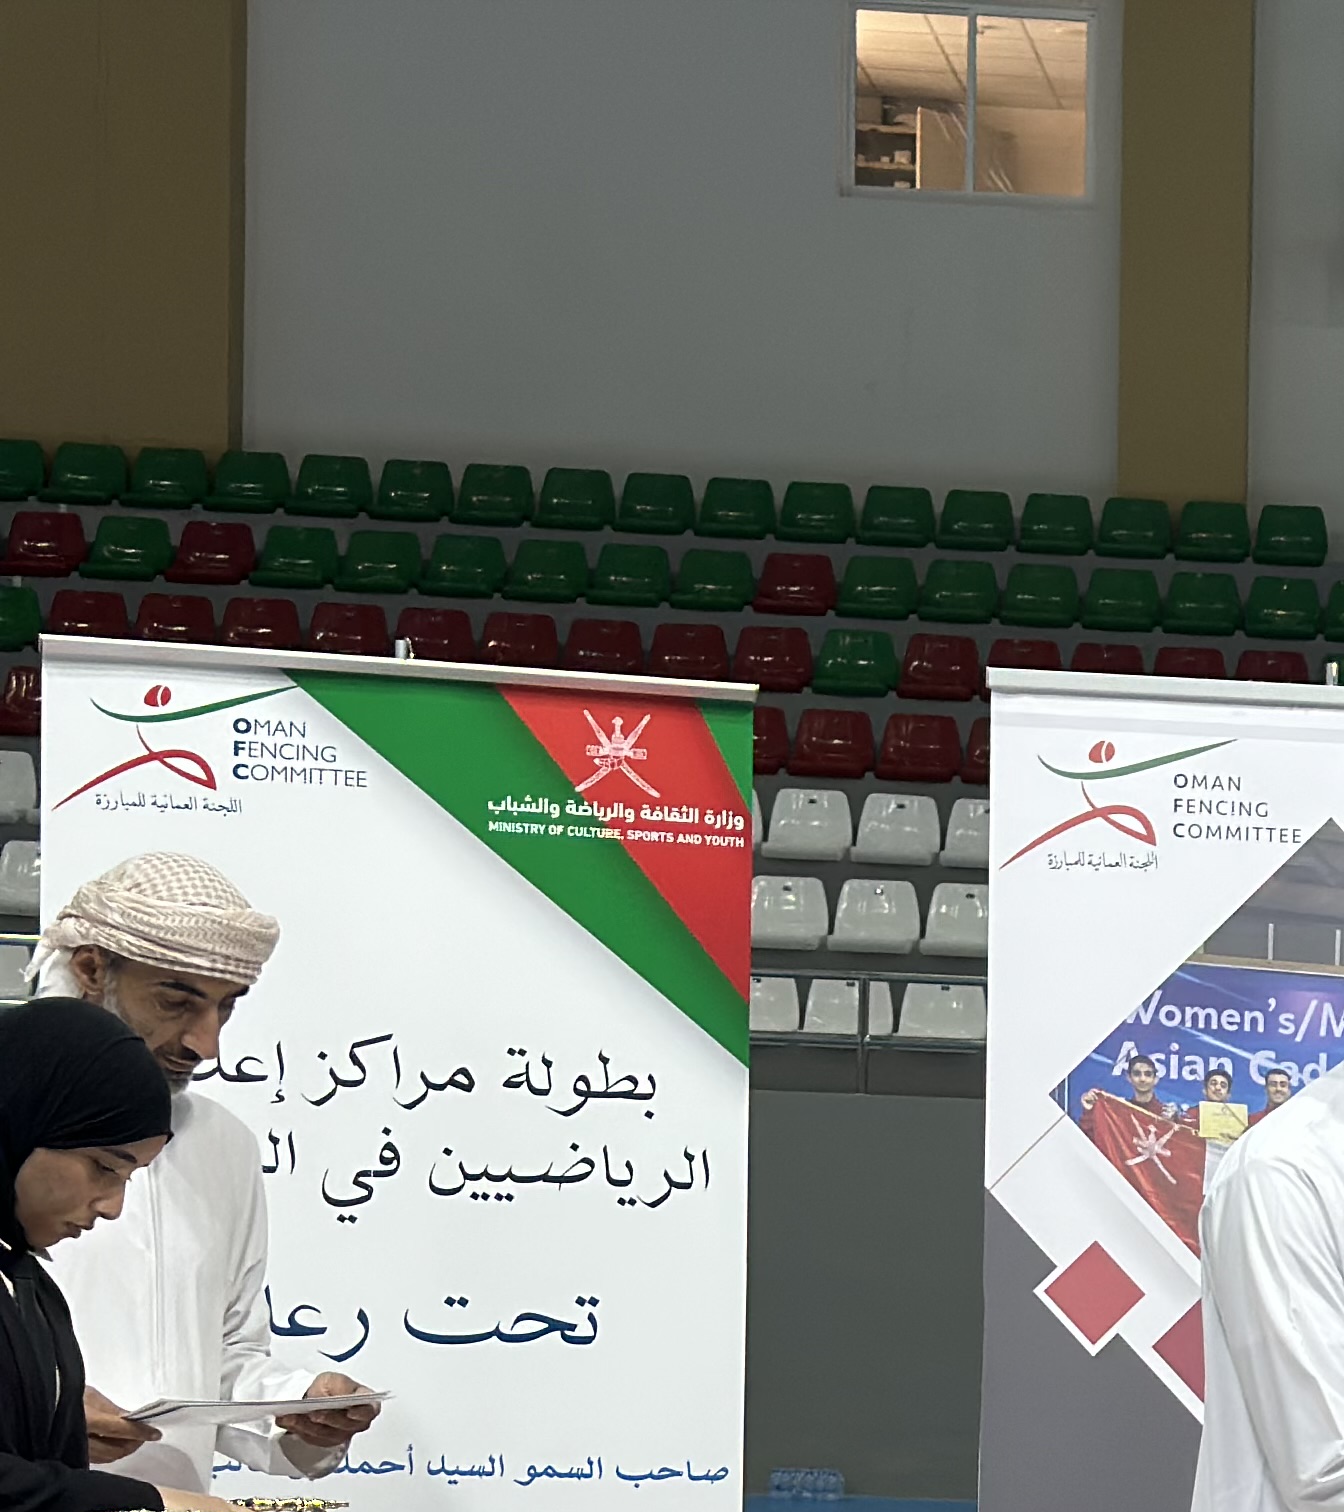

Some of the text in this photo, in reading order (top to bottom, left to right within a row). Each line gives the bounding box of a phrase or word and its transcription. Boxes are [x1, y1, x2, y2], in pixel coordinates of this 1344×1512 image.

[233, 717, 306, 738] OMAN
[233, 740, 337, 763] FENCING
[232, 763, 368, 788] COMMITTEE
[1173, 773, 1241, 792] OMAN
[95, 791, 242, 816] اللجنة العمانية للمبارزة
[488, 794, 744, 831] وزارة الثقافة والرياضة والشباب
[1173, 798, 1269, 818] FENCING
[488, 820, 745, 848] MINISTRY OF CULTURE, SPORTS AND YOUTH
[1172, 823, 1301, 844] COMMITTEE
[1048, 850, 1158, 872] اللجنة العمانية للمبارزة
[192, 1032, 656, 1120] بطولة مراكز إعد
[1249, 1050, 1327, 1087] Cad
[322, 1129, 400, 1223] في
[428, 1145, 710, 1209] الرياضيين
[264, 1284, 600, 1363] تحت رعا
[427, 1453, 504, 1485] السيد
[514, 1456, 603, 1485] السمو
[615, 1462, 729, 1488] صاحب
